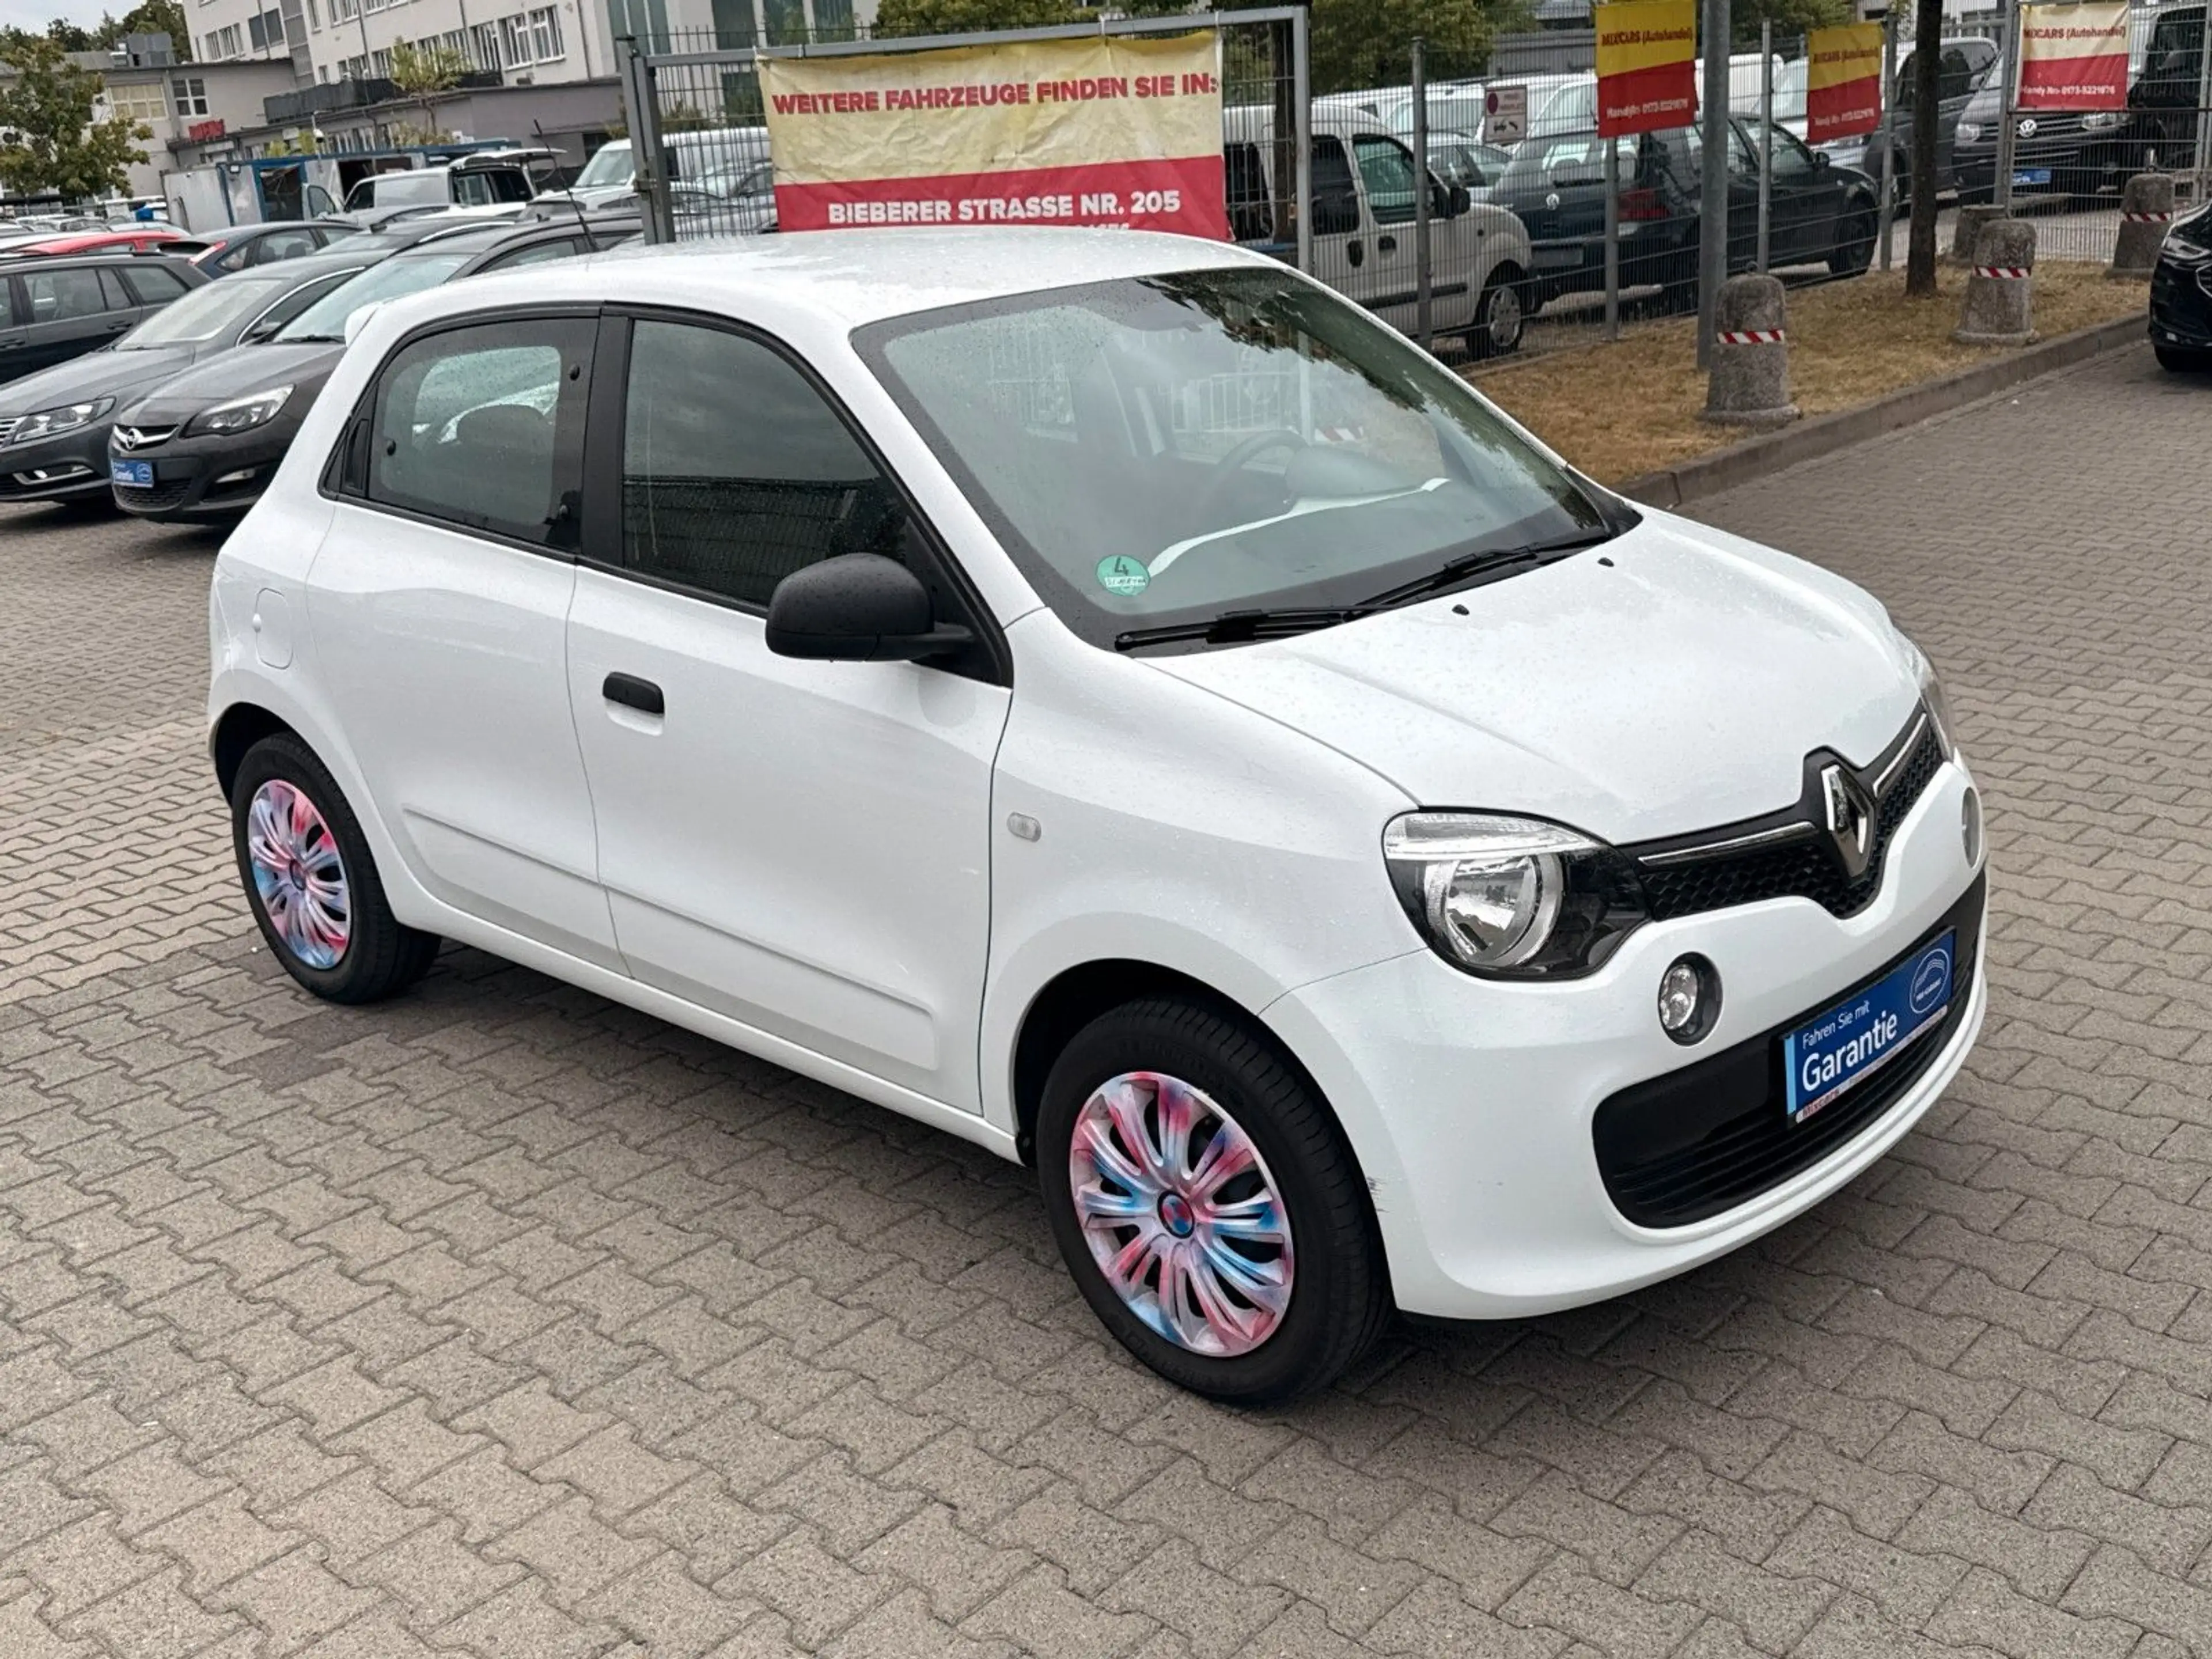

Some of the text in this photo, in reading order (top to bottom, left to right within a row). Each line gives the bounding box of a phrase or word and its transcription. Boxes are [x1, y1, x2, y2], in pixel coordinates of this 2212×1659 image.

[772, 73, 1218, 114] WEITERE FAHRZEUGE FINDEN SIE IN:
[828, 190, 1181, 224] BIEBERER STRASSE NR. 205
[1113, 556, 1129, 575] 4
[1802, 1000, 1870, 1050] Fahren Sie mit
[1802, 1010, 1897, 1092] Garantie
